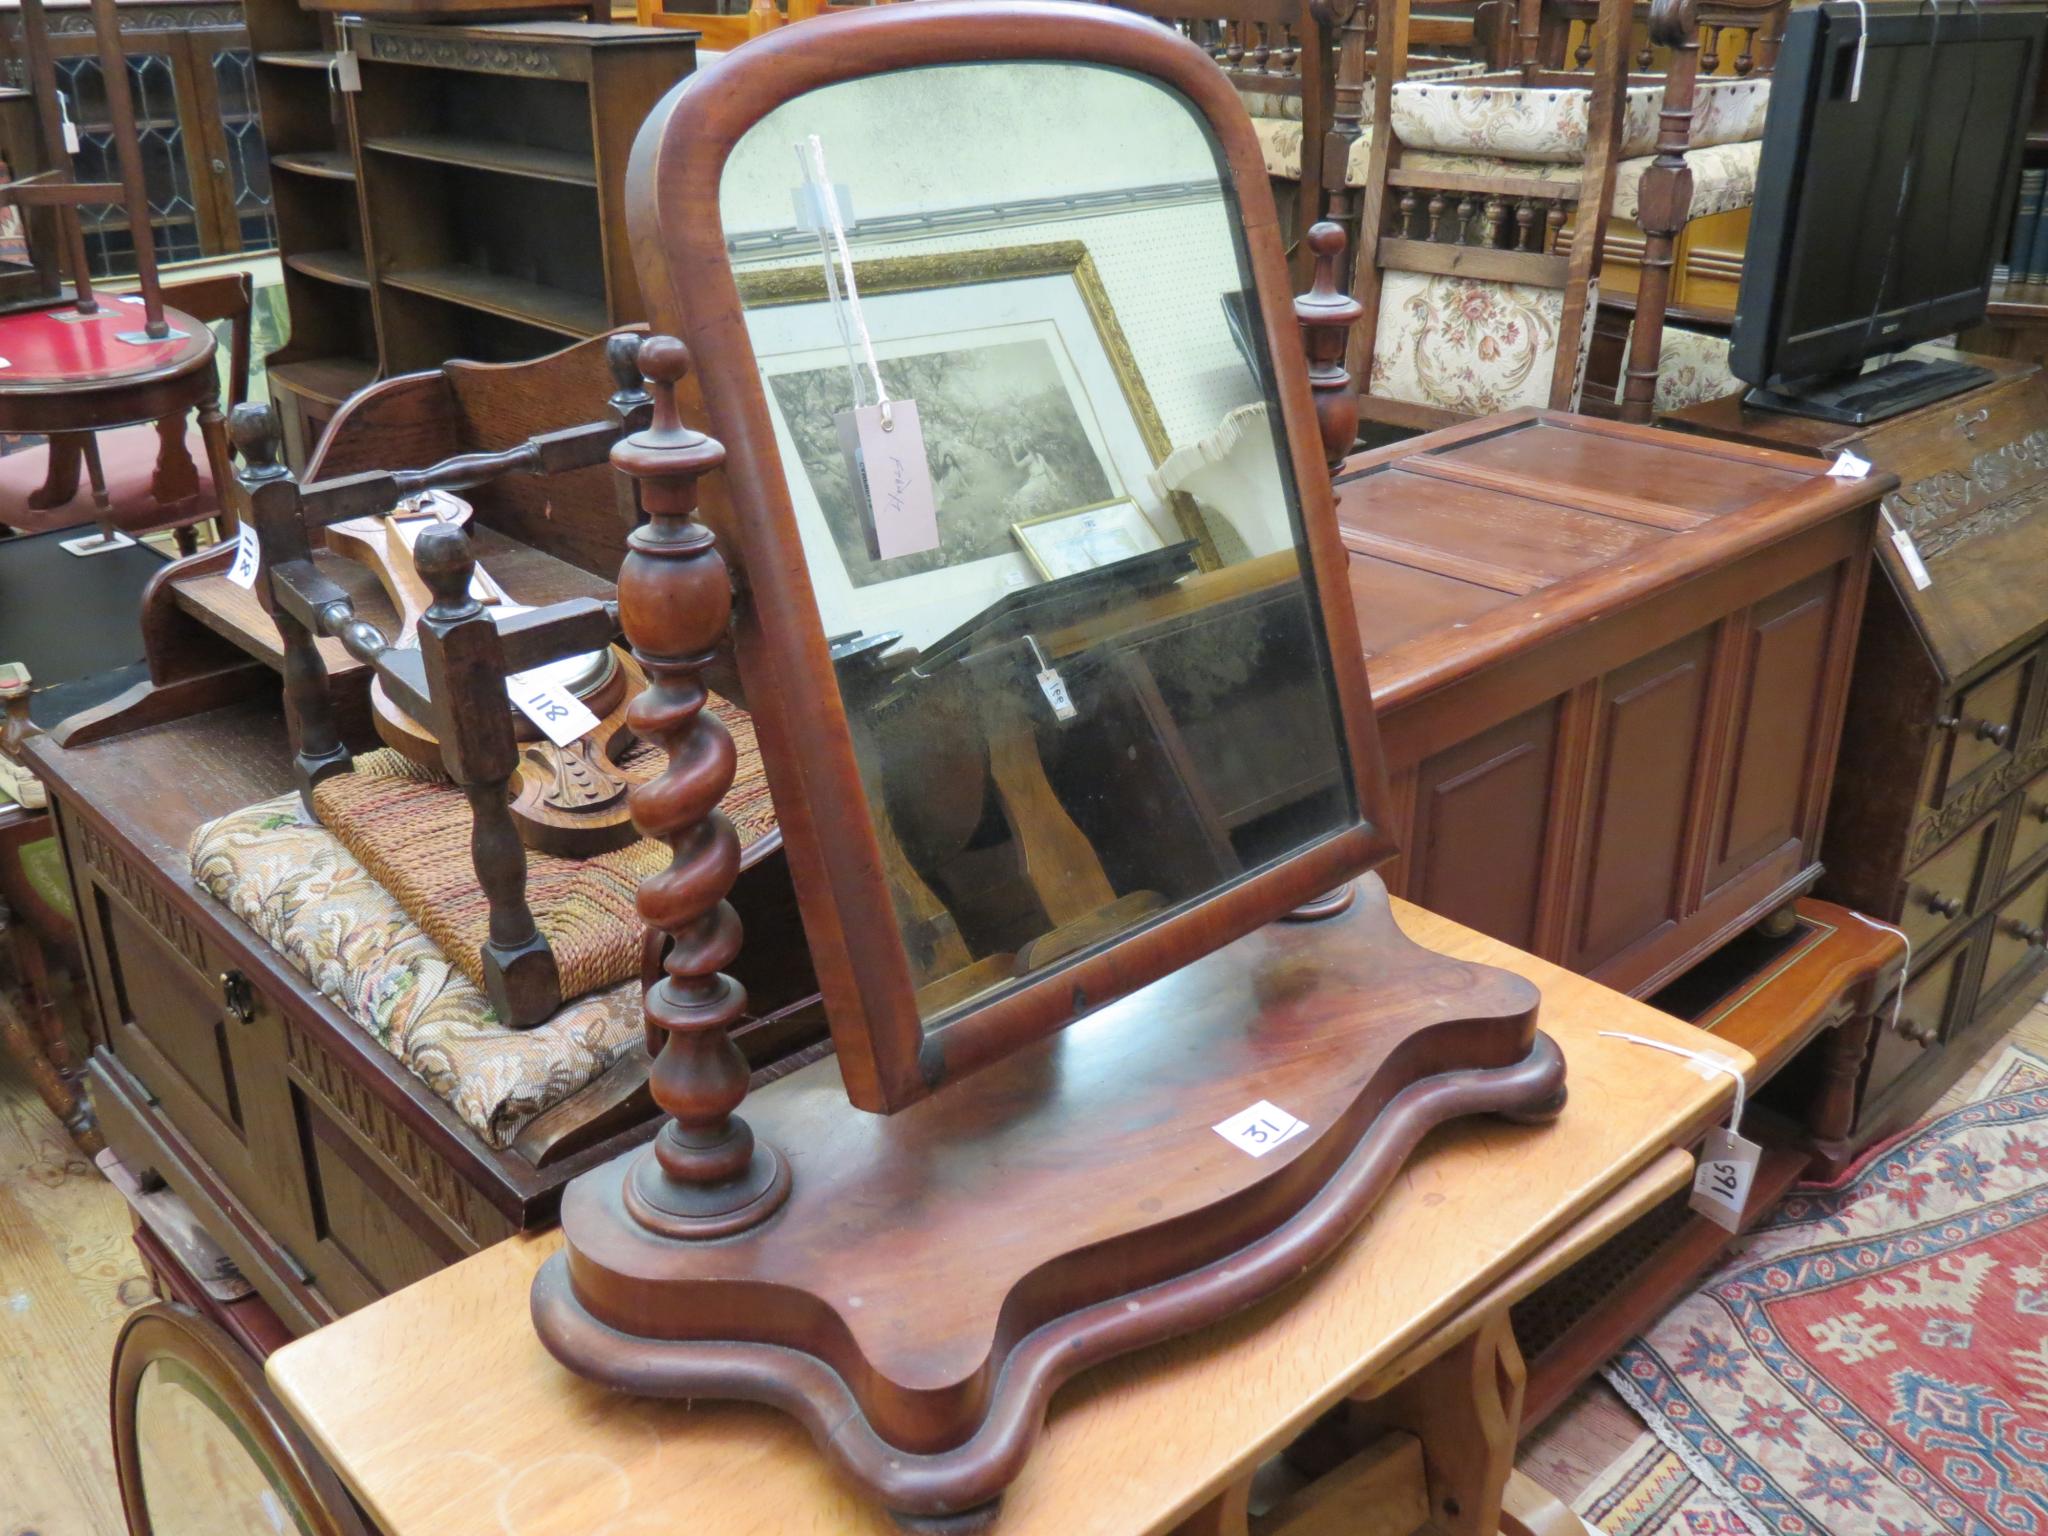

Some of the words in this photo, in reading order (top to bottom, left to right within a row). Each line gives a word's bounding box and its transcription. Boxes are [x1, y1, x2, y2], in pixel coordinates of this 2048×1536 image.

[239, 535, 254, 577] 118
[528, 692, 570, 722] 118
[1241, 1118, 1281, 1144] 31
[1710, 1162, 1738, 1201] 165
